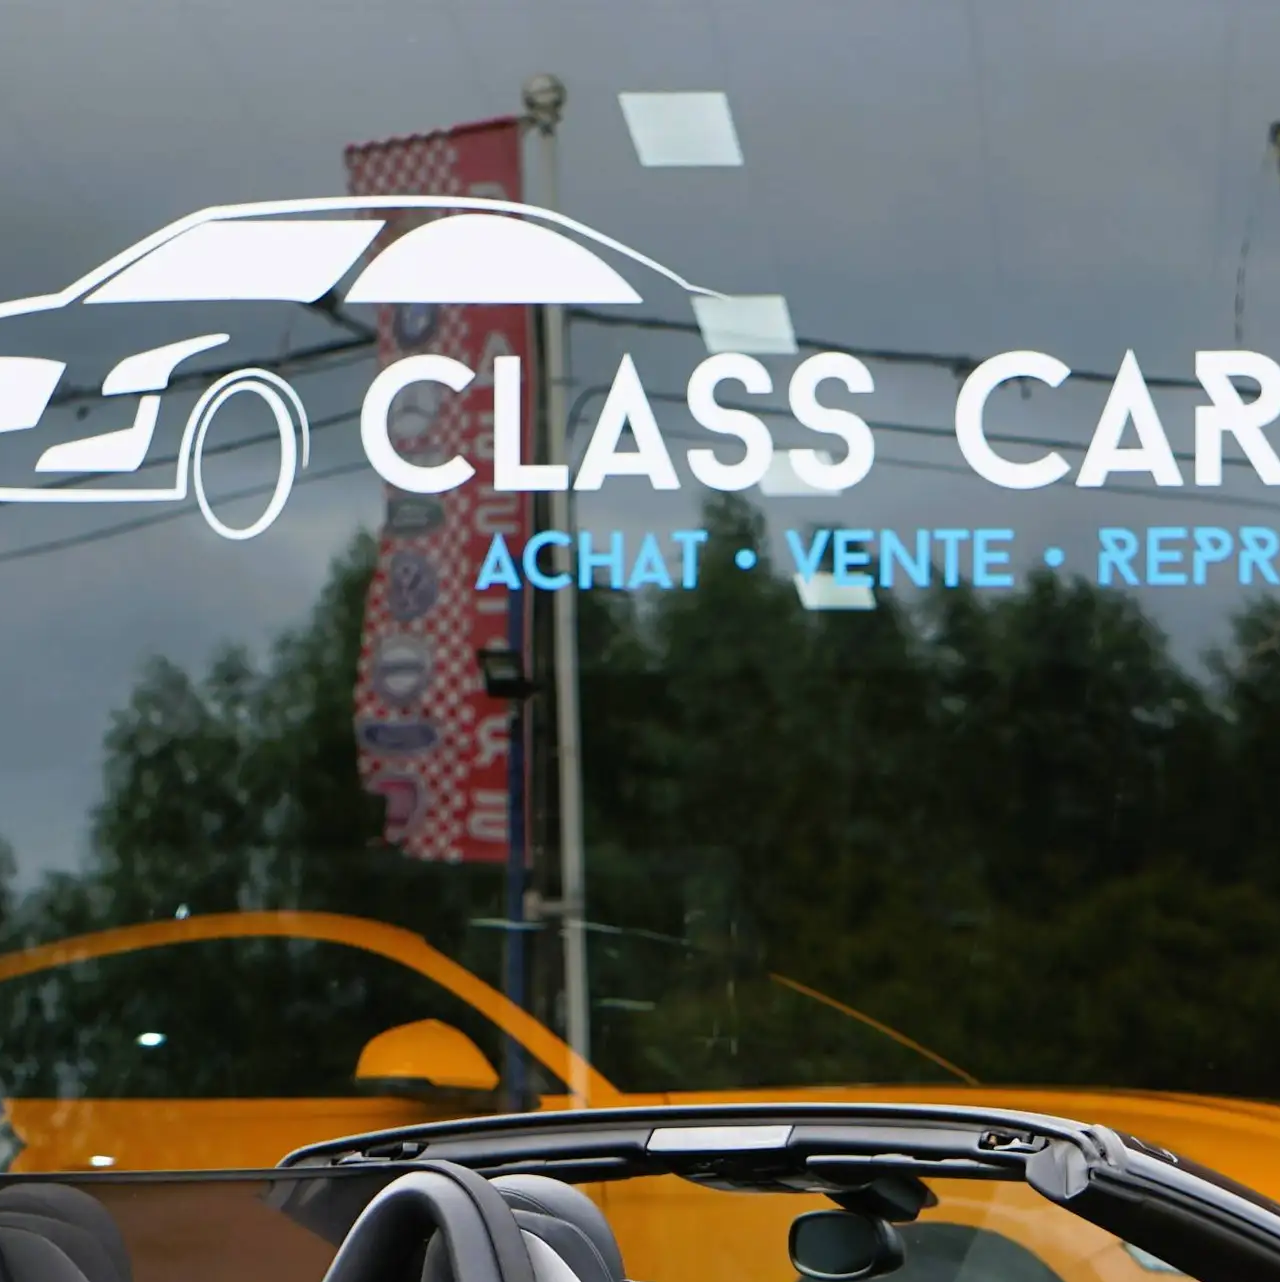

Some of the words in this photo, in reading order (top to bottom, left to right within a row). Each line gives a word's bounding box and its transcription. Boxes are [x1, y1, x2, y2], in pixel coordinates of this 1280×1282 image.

[361, 352, 874, 493] CLASS
[477, 530, 707, 590] ACHAT
[786, 529, 1014, 589] VENTE
